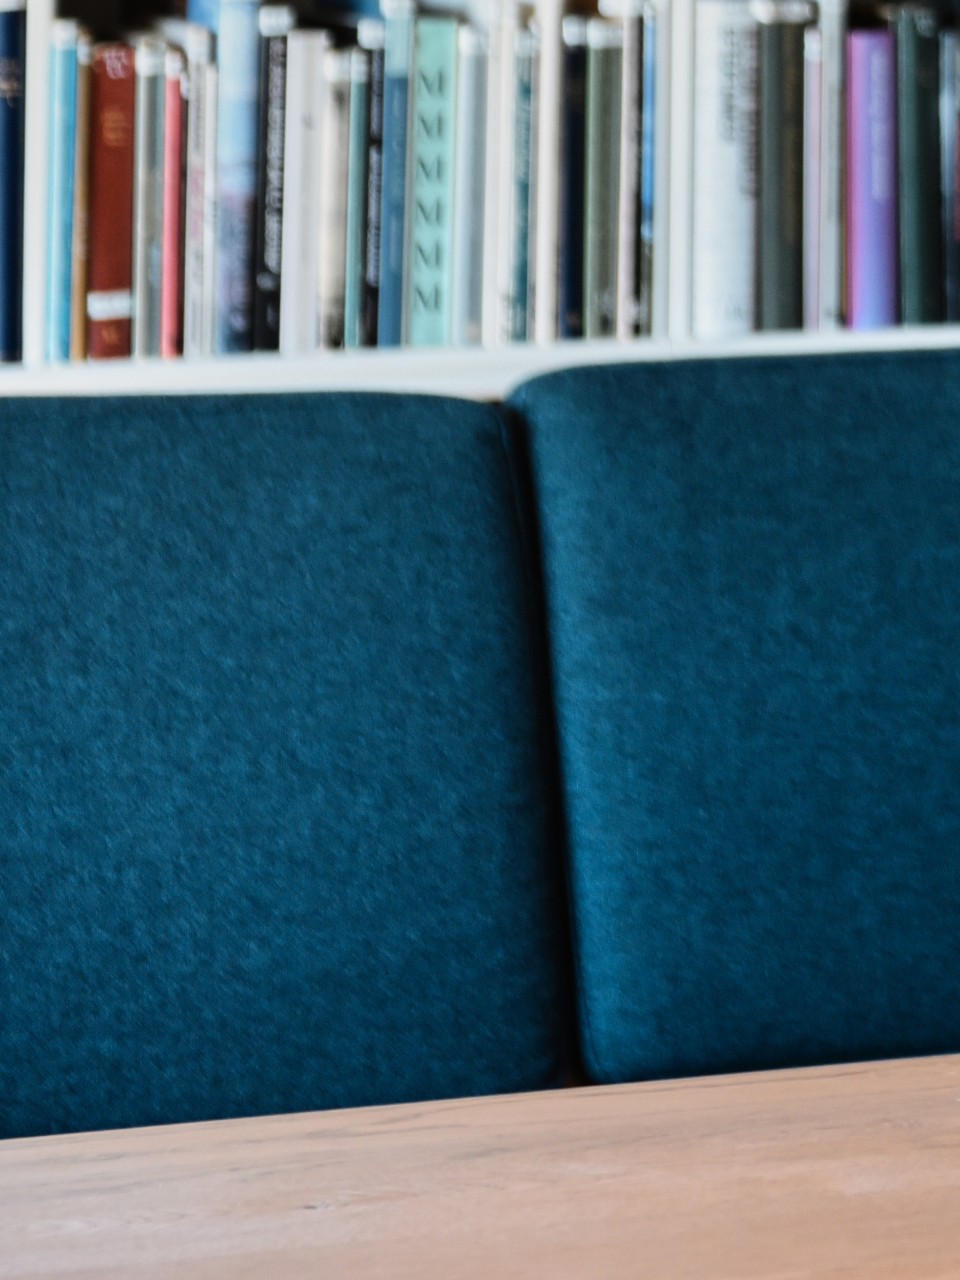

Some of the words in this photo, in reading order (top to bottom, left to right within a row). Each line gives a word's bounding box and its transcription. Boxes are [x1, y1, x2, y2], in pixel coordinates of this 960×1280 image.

[417, 70, 443, 96] M
[417, 113, 442, 139] M
[416, 156, 441, 181] M
[415, 199, 442, 225] M
[415, 241, 441, 267] M
[414, 285, 440, 312] M
